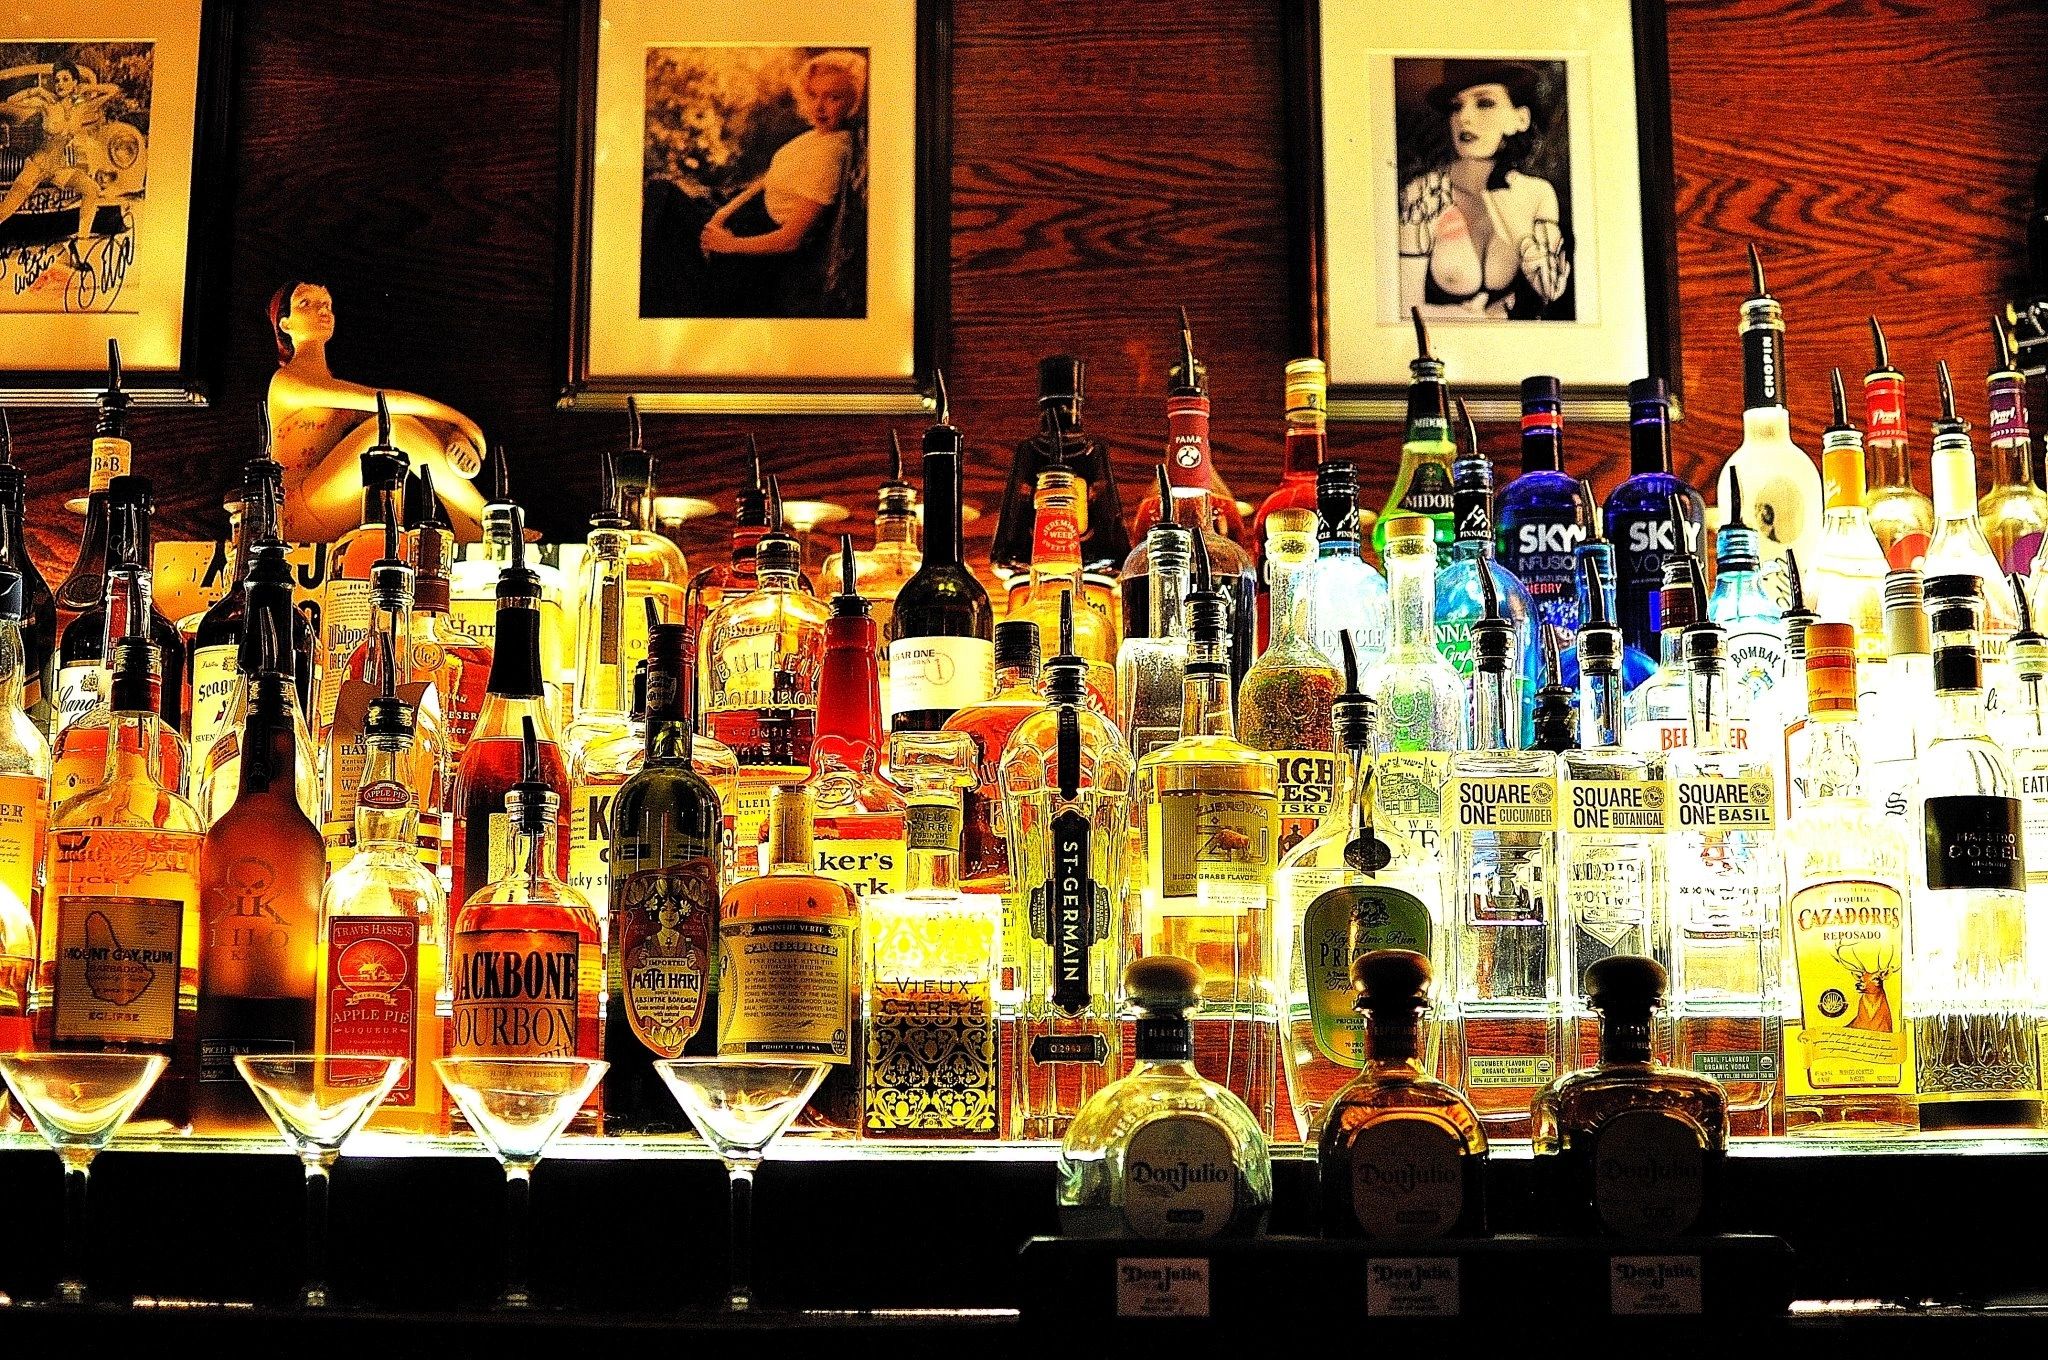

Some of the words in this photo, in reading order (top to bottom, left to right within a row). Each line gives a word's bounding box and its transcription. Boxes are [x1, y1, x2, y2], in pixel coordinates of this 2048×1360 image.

[1762, 336, 1775, 398] CHOPIN
[1175, 436, 1202, 444] PAMA
[1405, 494, 1455, 509] MIDOR
[1049, 531, 1074, 539] WEED
[1629, 521, 1701, 552] SKY
[1519, 554, 1577, 571] INFUSIO
[450, 619, 496, 638] Harr
[913, 648, 936, 659] ONE
[1731, 645, 1781, 668] BOMBAY
[59, 686, 98, 715] Cana
[447, 711, 480, 722] ESER
[366, 787, 391, 799] APPLE
[393, 788, 407, 799] PIE
[1459, 782, 1531, 806] SQUARE
[1572, 786, 1643, 809] SQUARE
[1678, 783, 1749, 806] SQUARE
[1281, 804, 1328, 814] ISKE
[1460, 804, 1497, 825] ONE
[1499, 808, 1552, 823] CUCUMBER
[1679, 804, 1716, 825] ONE
[1718, 808, 1770, 821] BASIL
[915, 811, 949, 823] VIEUX
[1573, 807, 1610, 829] ONE
[1612, 812, 1665, 826] BOTANICAL
[818, 851, 894, 871] ker's
[569, 871, 593, 890] ucky
[1198, 873, 1226, 881] GRASS
[855, 877, 890, 898] rk
[1834, 896, 1871, 905] TEQUILA
[1798, 906, 1900, 931] CAZADORES
[335, 924, 370, 938] TRAVIS
[371, 924, 413, 939] HASSE'S
[1385, 930, 1418, 945] Rum
[1823, 931, 1882, 942] REPOSADO
[113, 948, 140, 961] GAY
[142, 949, 174, 964] RUM
[632, 967, 666, 991] MATA
[667, 973, 700, 993] HARI
[895, 976, 970, 995] VIEUX
[635, 996, 666, 1004] ABSINTHE
[332, 1009, 380, 1024] APPLE
[384, 1009, 410, 1024] PIE
[344, 1027, 398, 1035] LIQUEUR
[1505, 1059, 1533, 1067] FLAVORED
[1704, 1063, 1729, 1071] ORGANIC
[1730, 1063, 1750, 1071] VODKA
[1481, 1067, 1506, 1075] ORGANIC
[1507, 1067, 1525, 1075] VODKA
